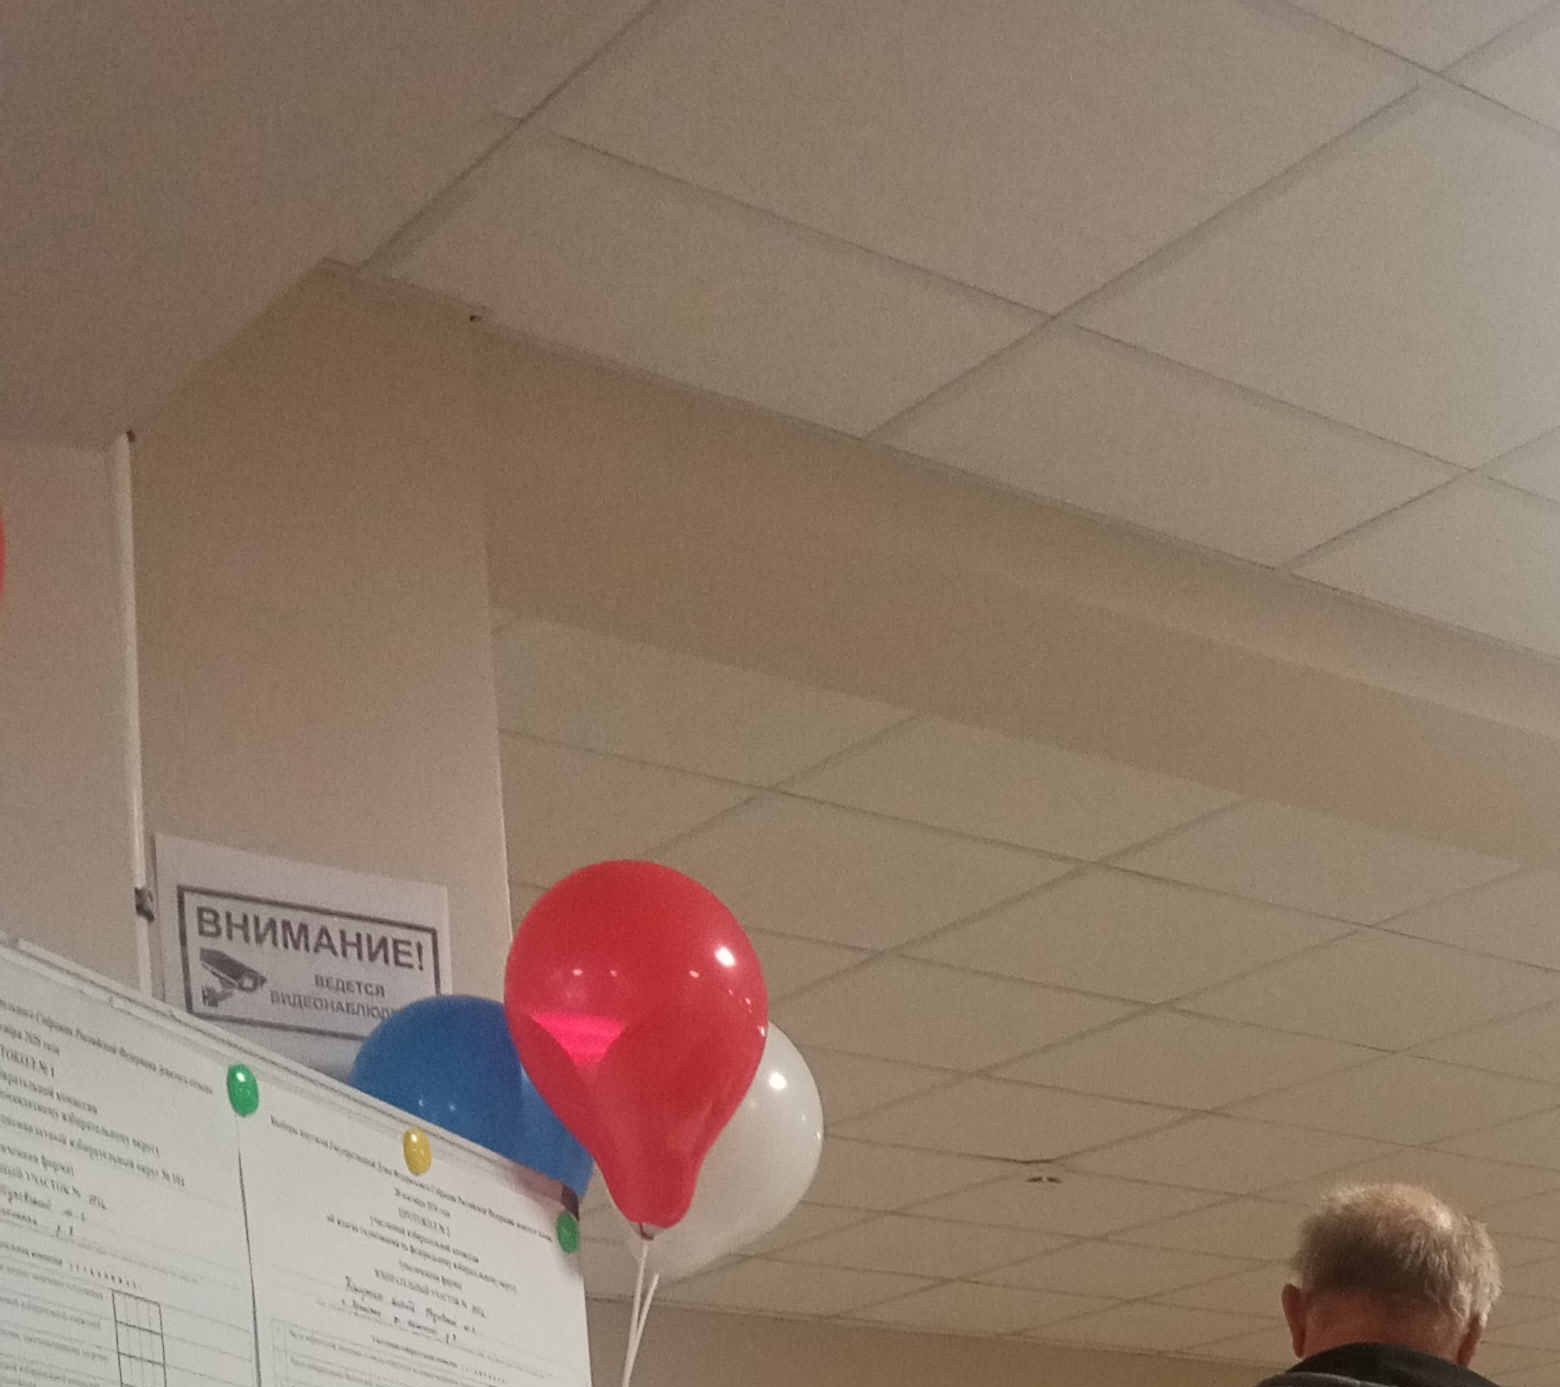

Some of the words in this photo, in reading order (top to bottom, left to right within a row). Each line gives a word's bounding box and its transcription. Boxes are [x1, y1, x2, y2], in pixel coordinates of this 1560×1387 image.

[196, 906, 424, 971] ВНИМАНИЕ!
[314, 973, 385, 998] ВЕДЕТСЯ
[269, 988, 393, 1020] ВИДЕОНАБЛЮД
